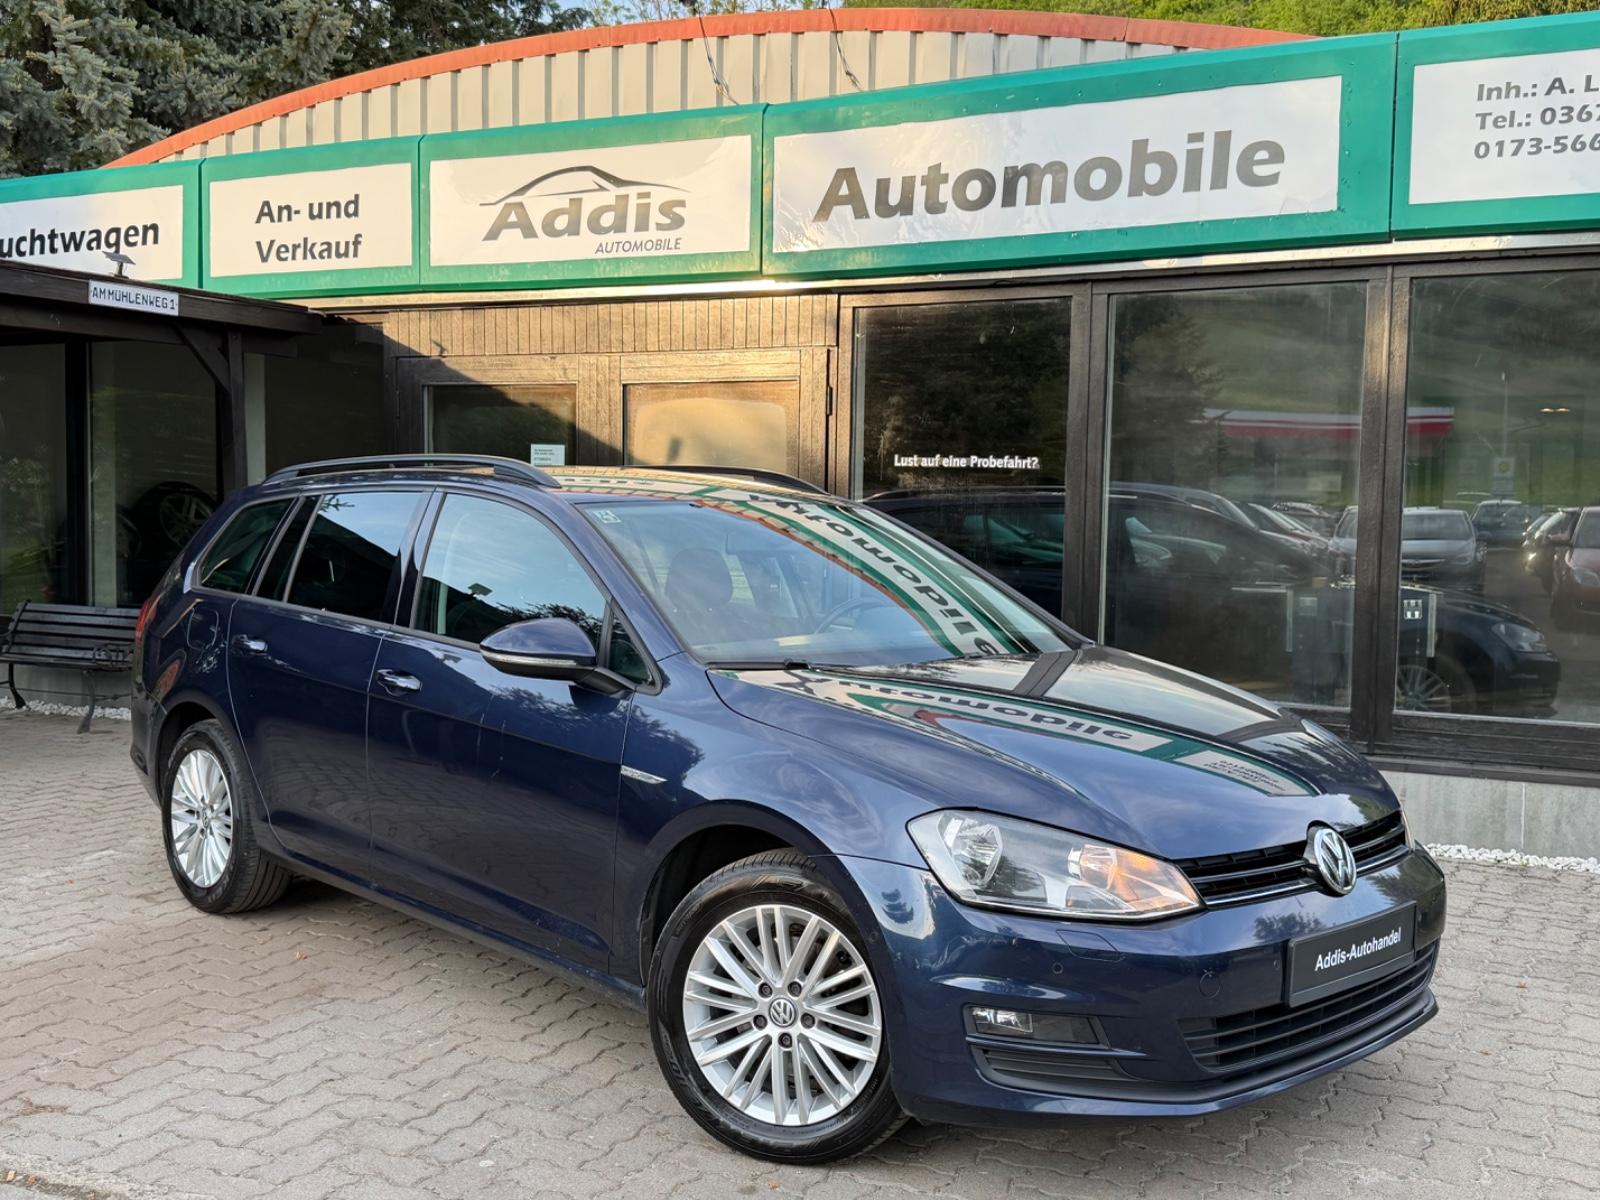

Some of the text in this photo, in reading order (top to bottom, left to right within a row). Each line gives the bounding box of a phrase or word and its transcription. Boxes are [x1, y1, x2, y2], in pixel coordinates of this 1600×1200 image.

[1477, 82, 1538, 101] Inh.:
[1544, 76, 1575, 96] A.
[1475, 111, 1531, 130] Tel.:
[812, 129, 1285, 223] Automobile
[255, 194, 360, 224] An- und
[481, 192, 687, 242] Addis
[255, 234, 363, 263] Verkauf
[594, 238, 682, 254] AUTOMOBILE
[92, 286, 175, 310] AM MÜHLENWEG 1
[894, 454, 1039, 469] Lust auf eine Probefahrt?
[1314, 927, 1401, 972] Addis-Autohandel
